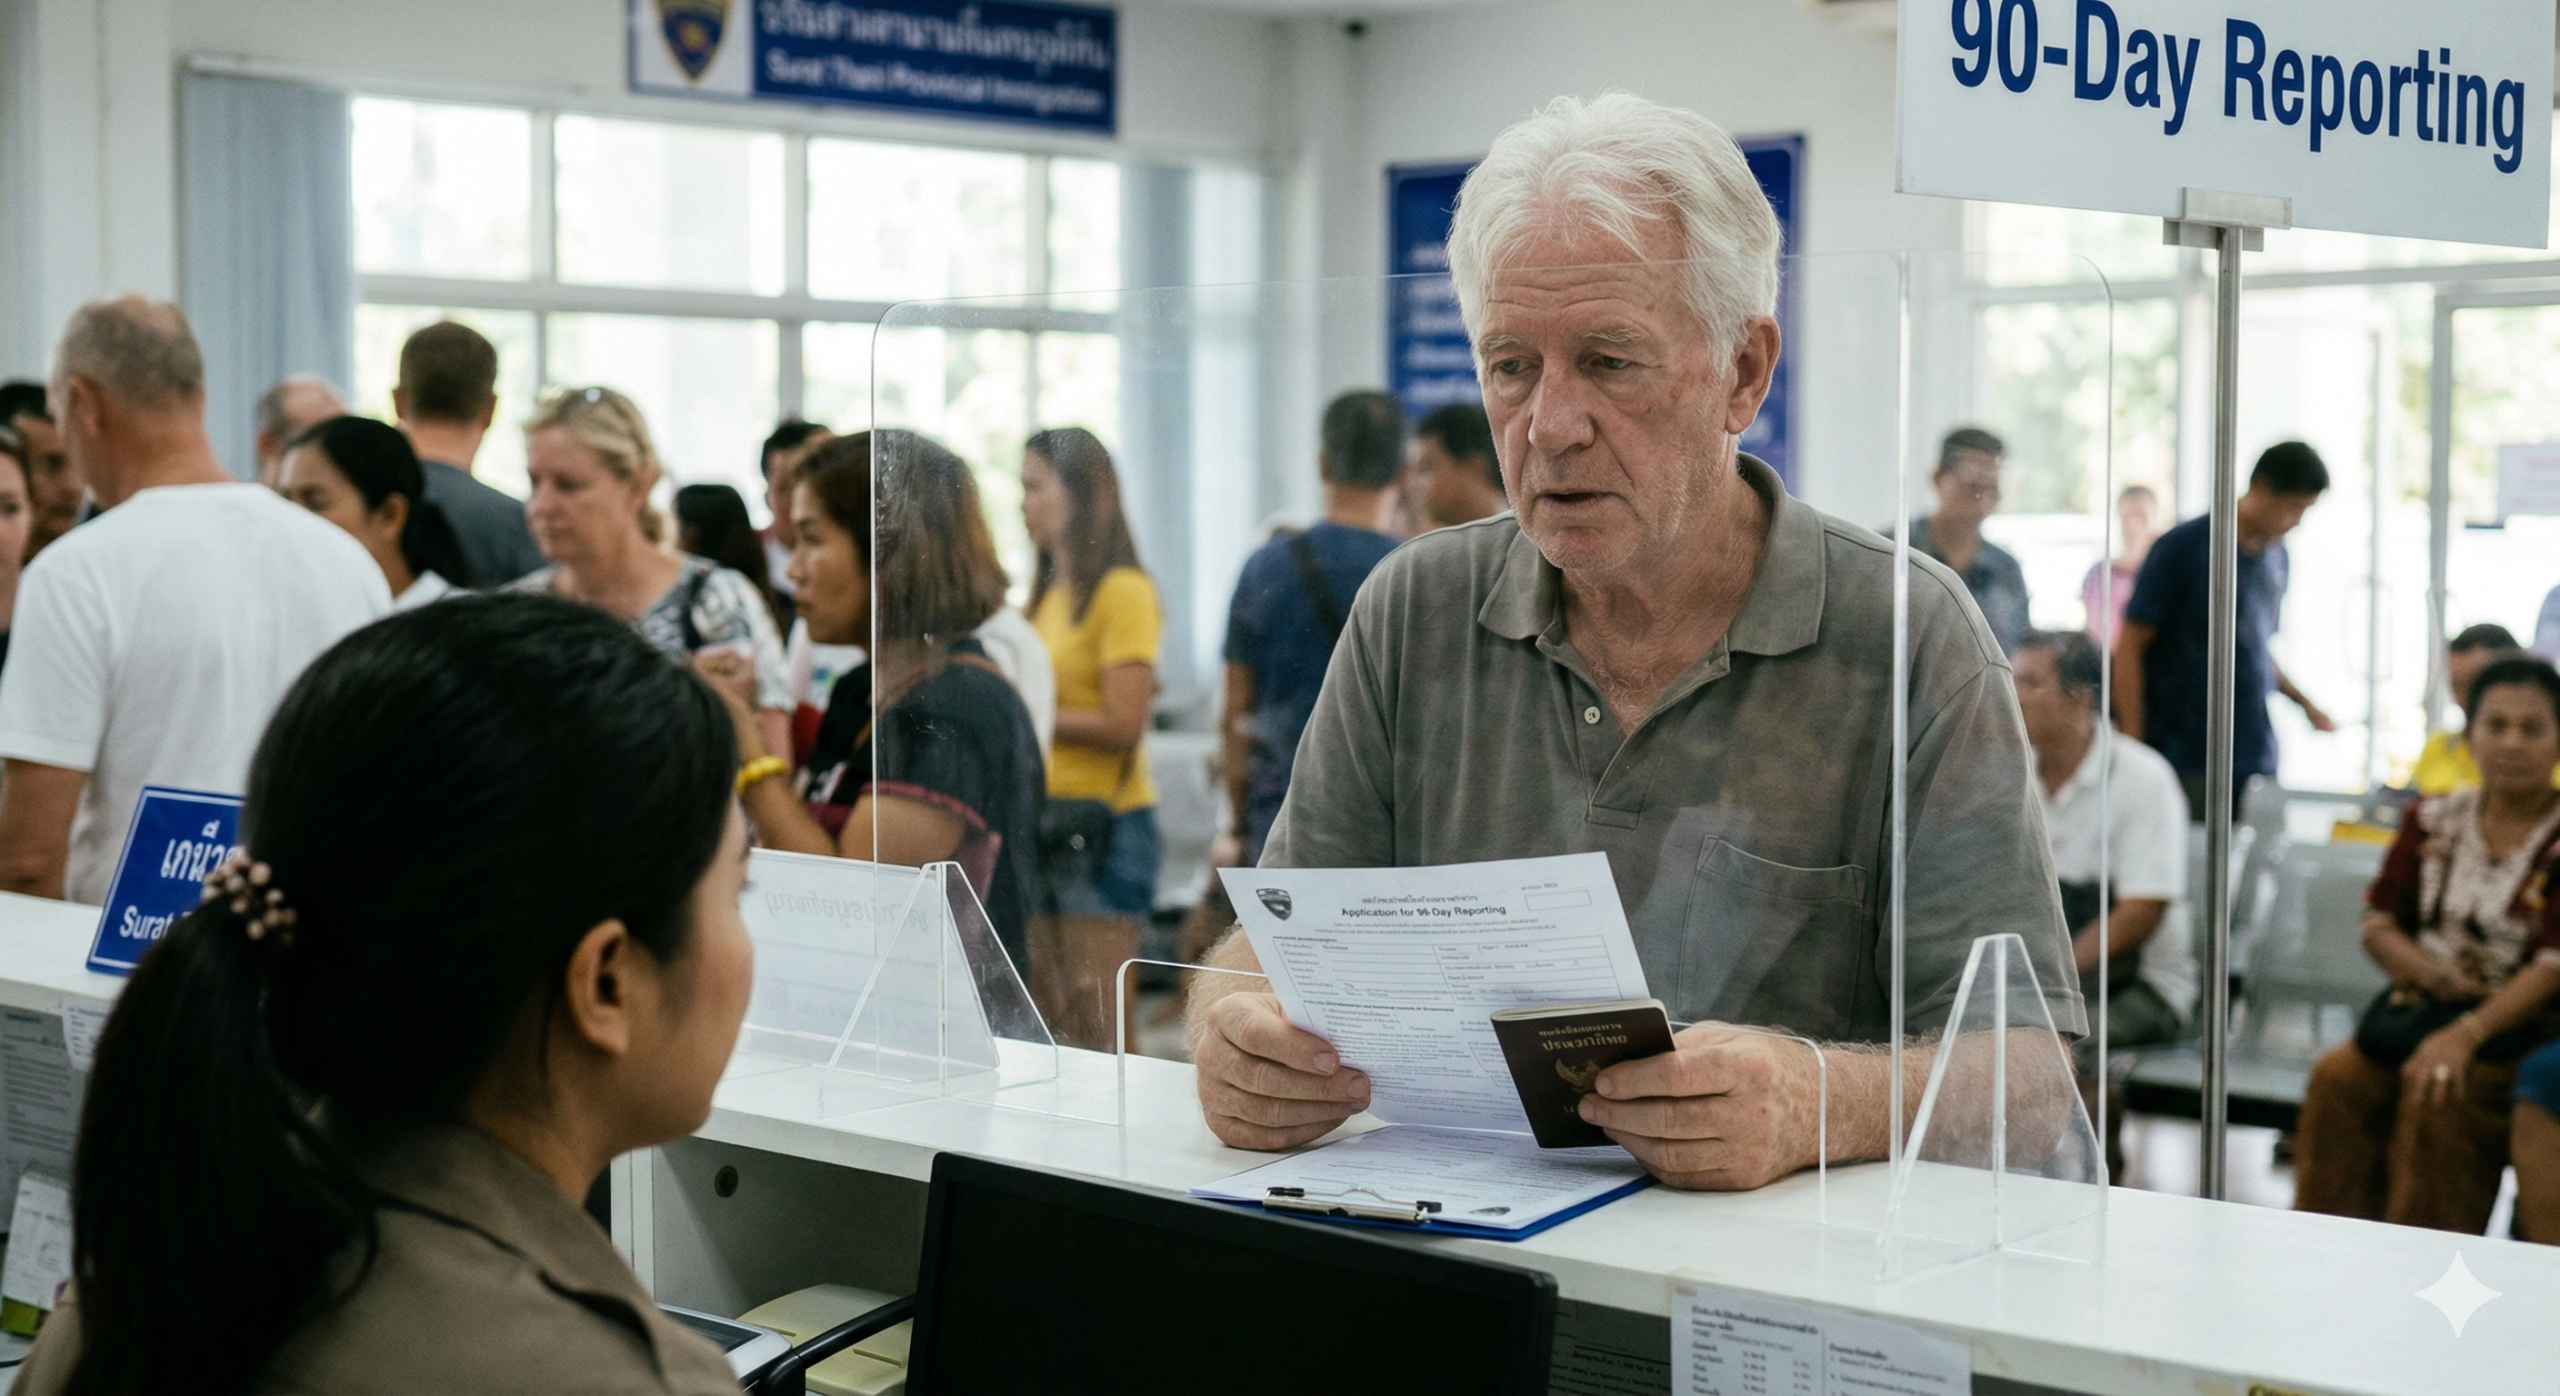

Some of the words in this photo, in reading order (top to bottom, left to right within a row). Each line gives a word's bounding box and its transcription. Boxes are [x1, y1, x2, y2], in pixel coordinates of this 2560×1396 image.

[1951, 0, 2201, 136] 90-Day
[2223, 18, 2526, 174] Reporting
[1454, 905, 1507, 918] Reporting
